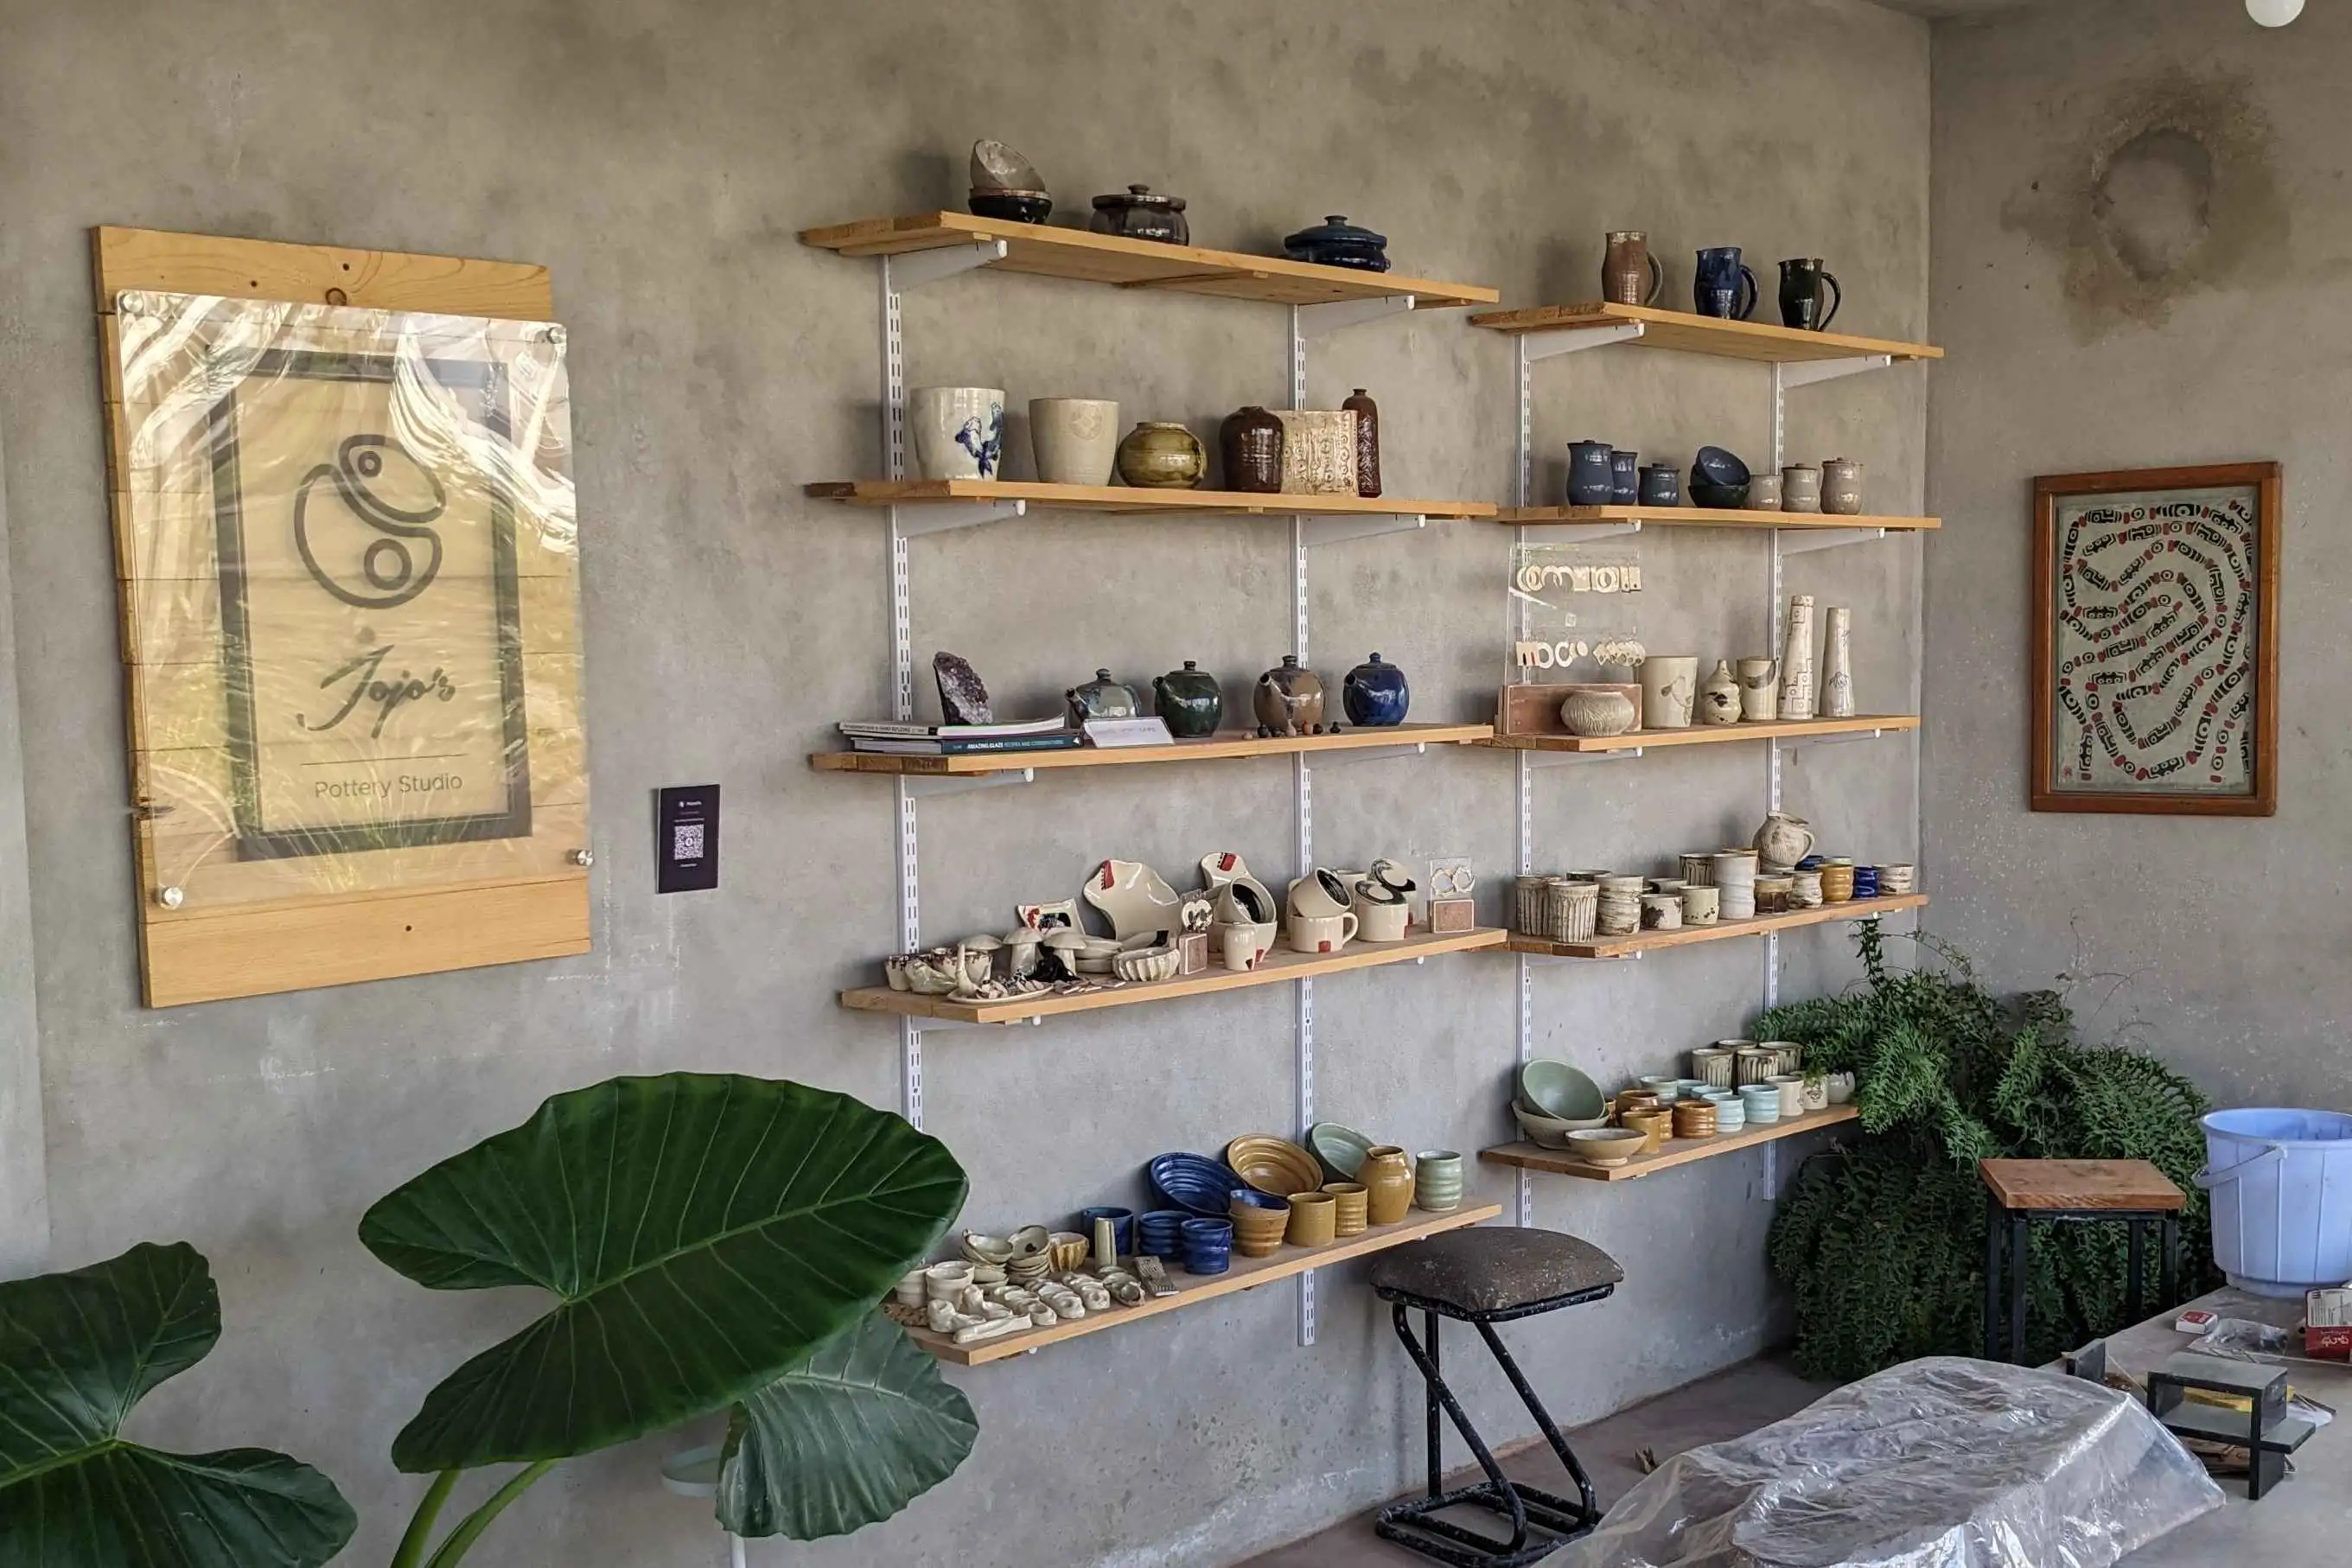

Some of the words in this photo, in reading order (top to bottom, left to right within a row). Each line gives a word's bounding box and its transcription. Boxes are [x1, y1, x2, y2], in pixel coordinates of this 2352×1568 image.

[296, 644, 456, 739] Jojo's
[315, 780, 392, 798] Pottery
[398, 773, 463, 794] Studio
